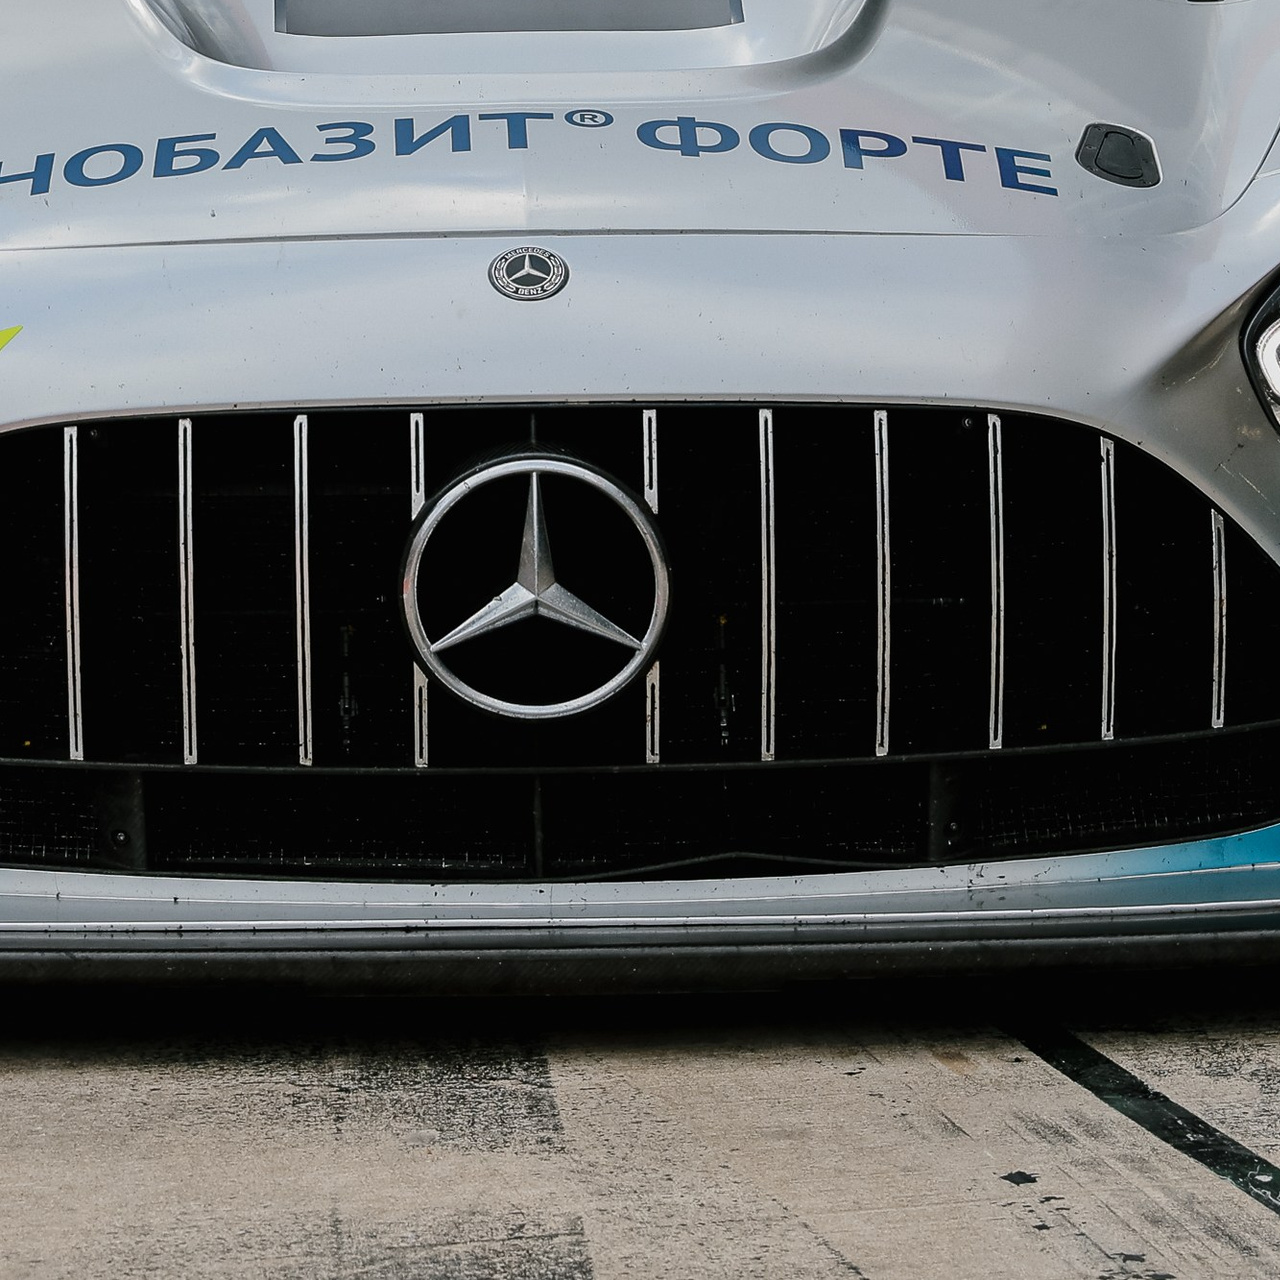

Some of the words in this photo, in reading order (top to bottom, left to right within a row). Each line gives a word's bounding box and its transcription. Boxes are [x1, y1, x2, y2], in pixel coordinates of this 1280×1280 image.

[636, 115, 1060, 197] ФОРТЕ
[505, 247, 551, 259] MERCEDES
[517, 287, 544, 296] BENZ
